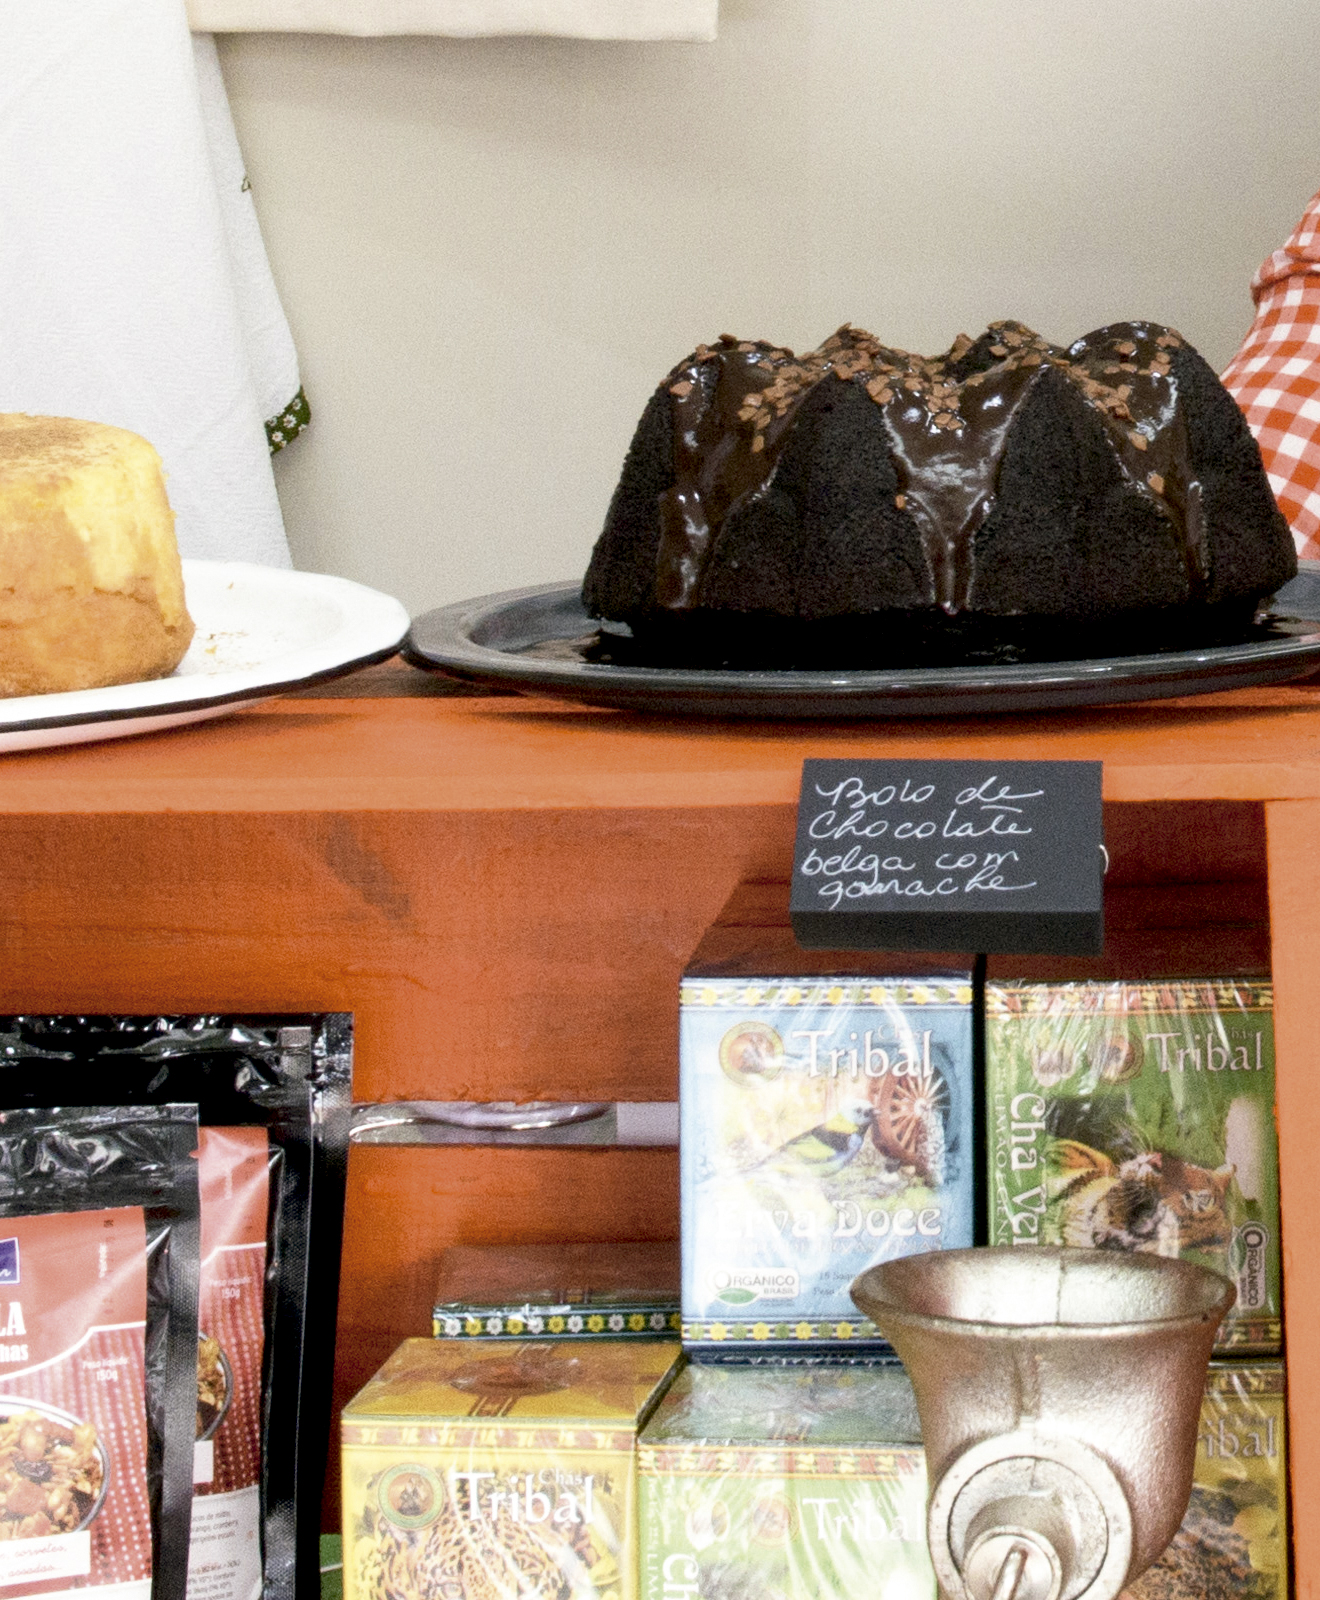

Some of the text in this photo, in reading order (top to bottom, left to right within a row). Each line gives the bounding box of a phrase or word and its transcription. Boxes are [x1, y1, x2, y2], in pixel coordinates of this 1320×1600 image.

[814, 775, 1045, 809] Bolo de
[808, 804, 1033, 839] Chocolate
[800, 845, 1019, 887] belga com
[791, 1028, 934, 1078] Tribal
[1146, 1030, 1265, 1073] Tribal
[1010, 1092, 1047, 1171] Chá
[716, 1198, 943, 1239] Erva Doce
[449, 1470, 596, 1524] Tribal
